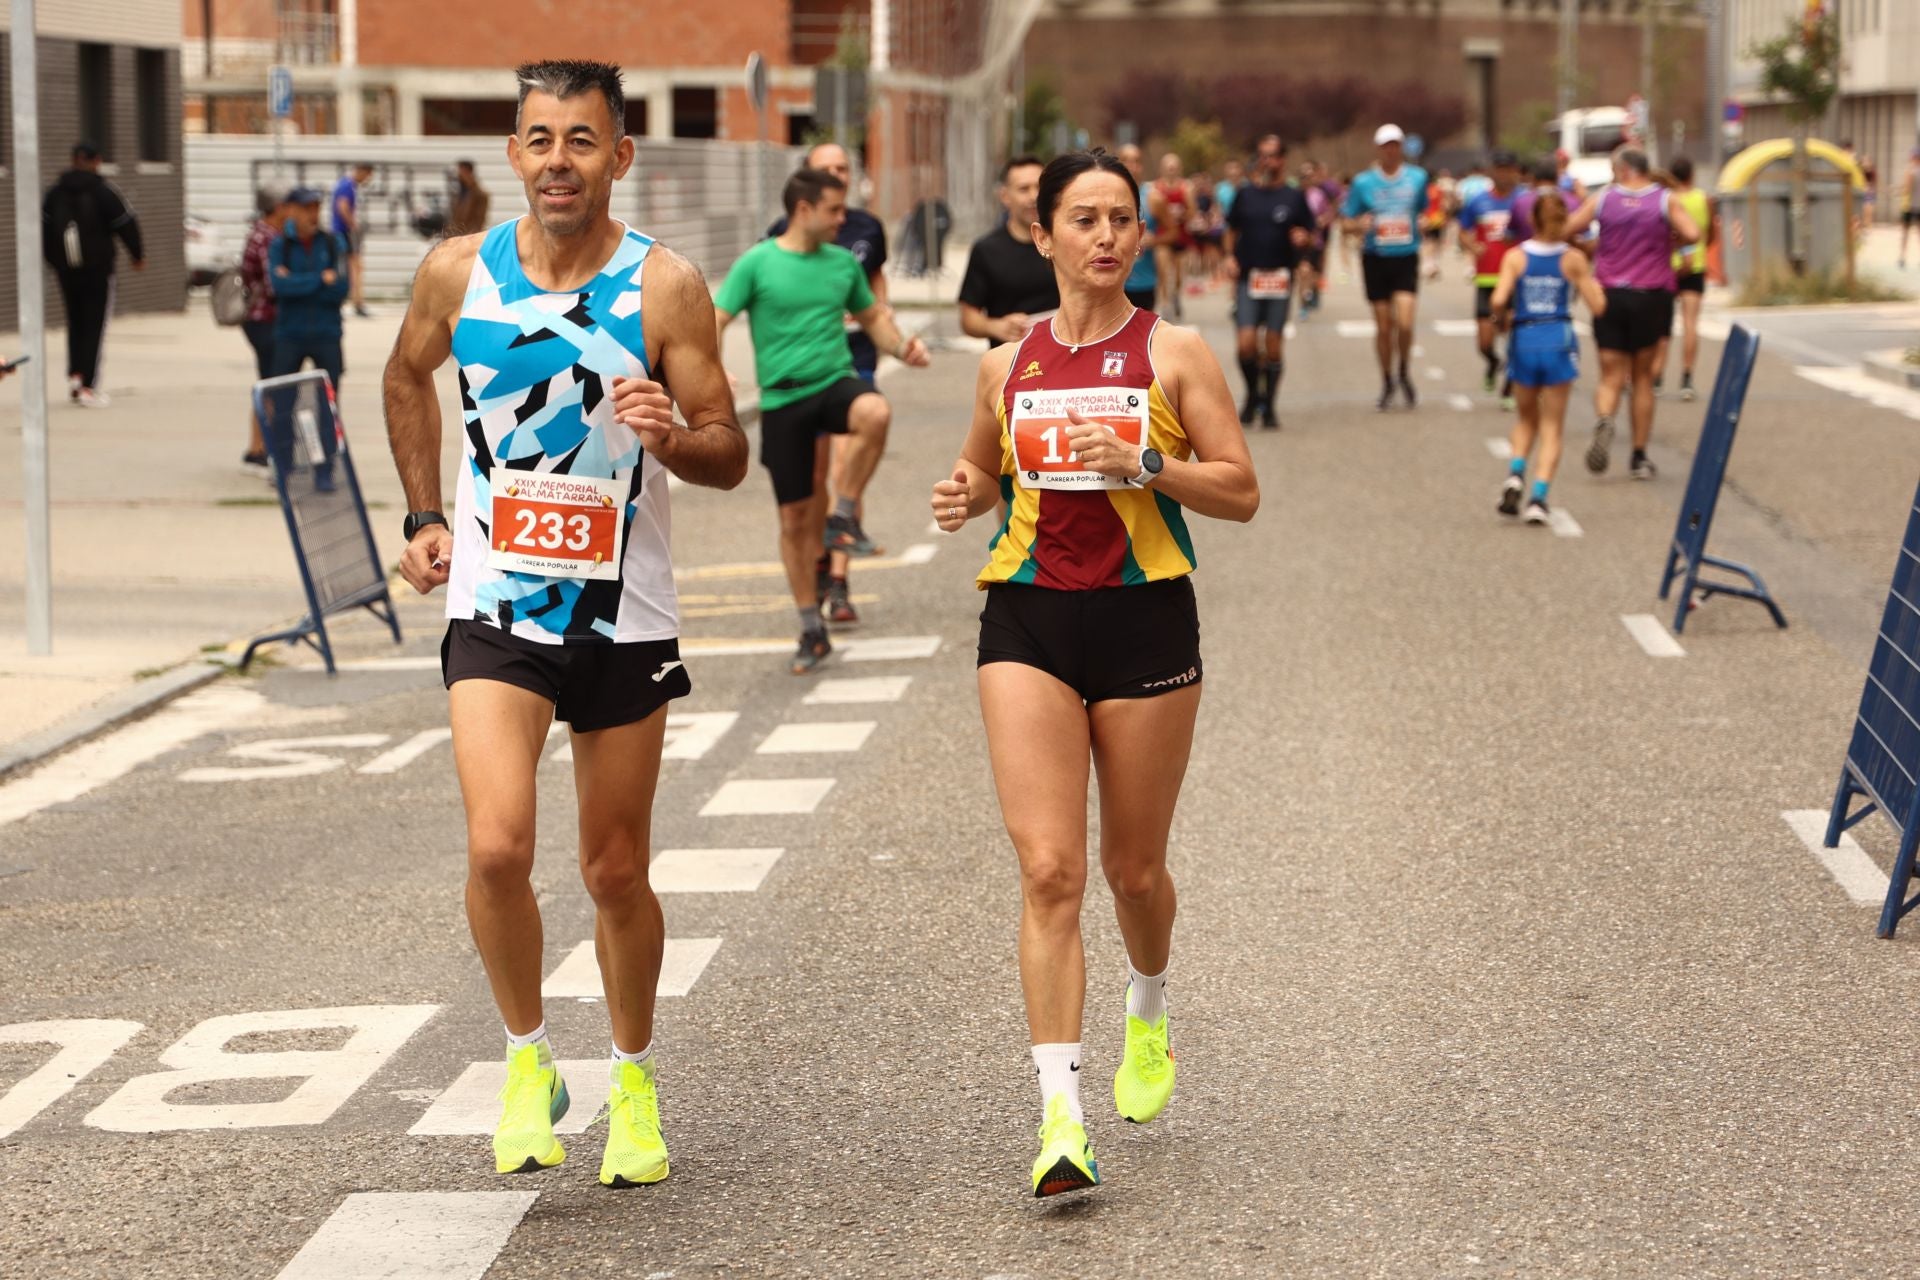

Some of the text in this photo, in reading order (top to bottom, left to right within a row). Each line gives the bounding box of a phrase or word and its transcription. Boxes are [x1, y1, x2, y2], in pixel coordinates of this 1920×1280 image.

[1039, 394, 1120, 407] XXIX MEMORIAL
[513, 478, 598, 495] XXIX MEMORIAL
[513, 508, 592, 552] 233
[516, 557, 578, 571] CARRERA POPULAR
